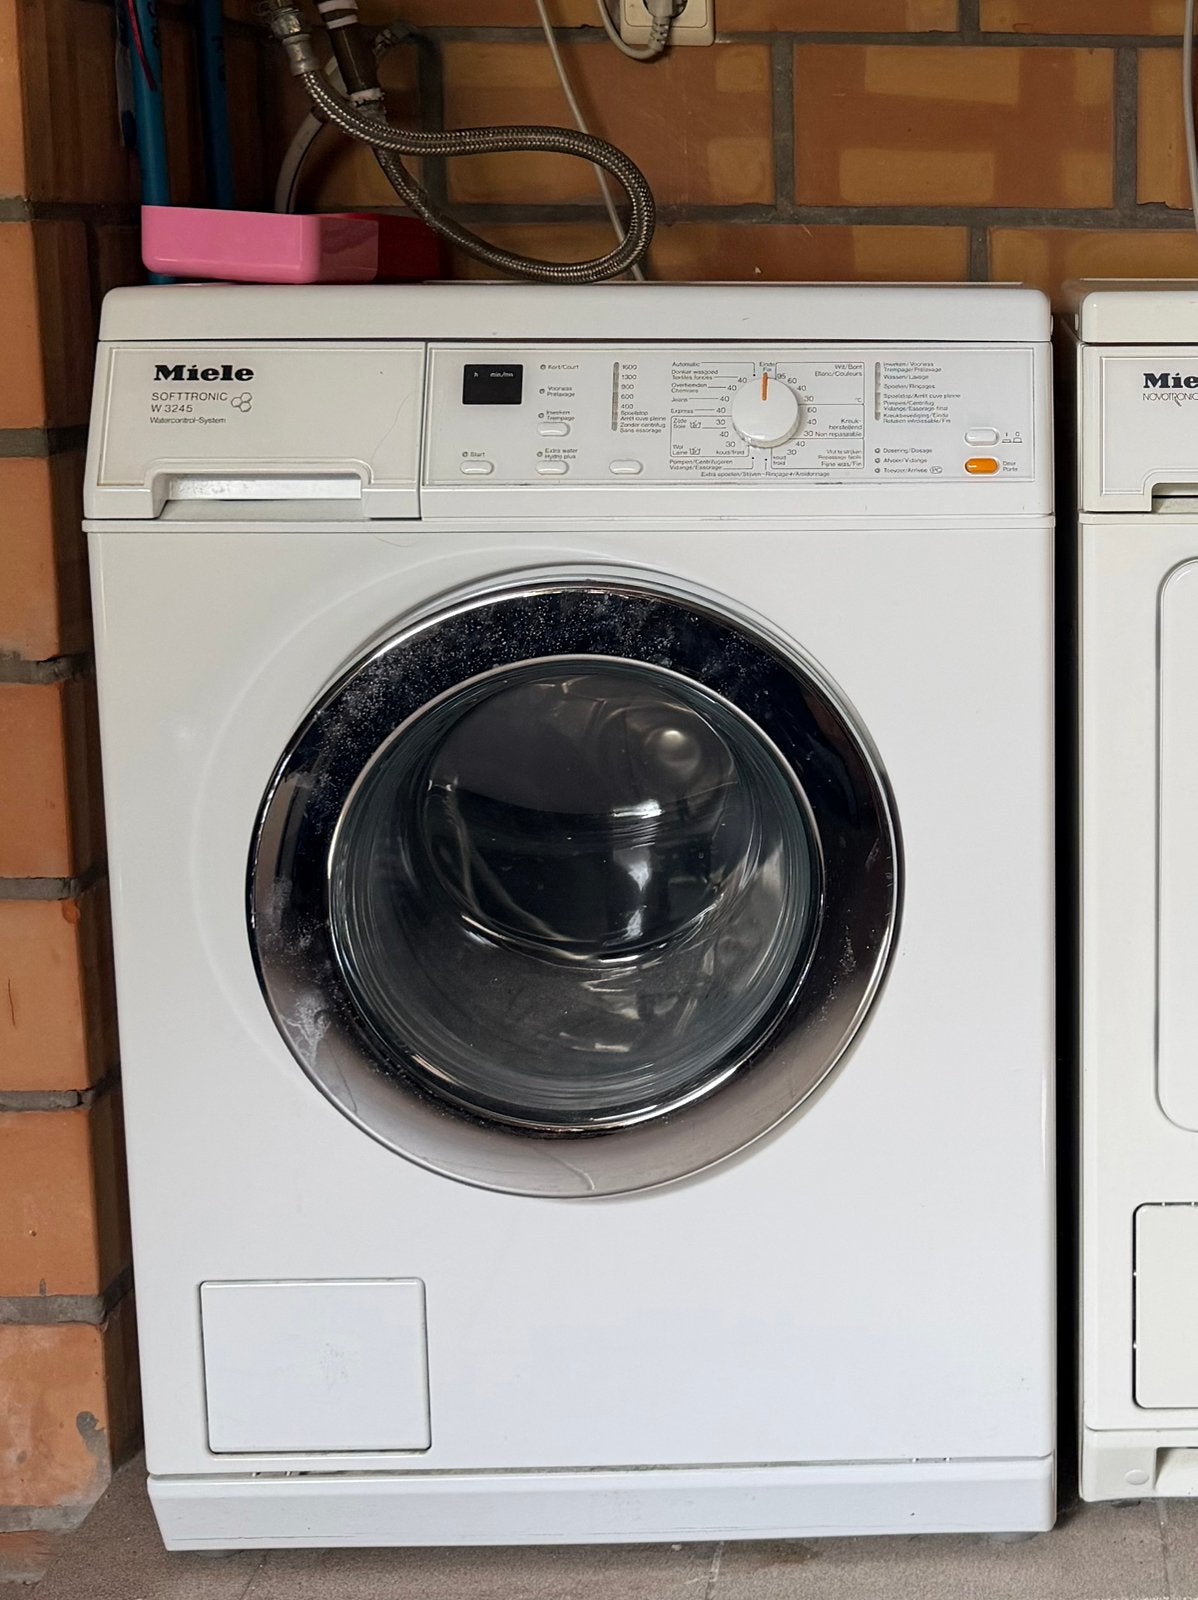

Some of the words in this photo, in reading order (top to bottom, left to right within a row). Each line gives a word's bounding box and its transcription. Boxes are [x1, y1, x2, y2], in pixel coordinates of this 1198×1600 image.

[153, 364, 254, 382] Miele
[787, 377, 798, 385] 60
[727, 384, 738, 392] 40
[151, 391, 228, 401] SOFTTRONIC
[720, 395, 731, 403] 40
[151, 404, 162, 413] W
[164, 404, 193, 413] 3245
[715, 406, 727, 414] 40
[807, 406, 818, 414] 60
[715, 419, 727, 427] 30
[806, 418, 818, 426] 40
[719, 430, 730, 438] 40
[803, 430, 814, 438] 30
[725, 440, 737, 448] 30
[795, 440, 806, 448] 40
[786, 448, 798, 456] 30
